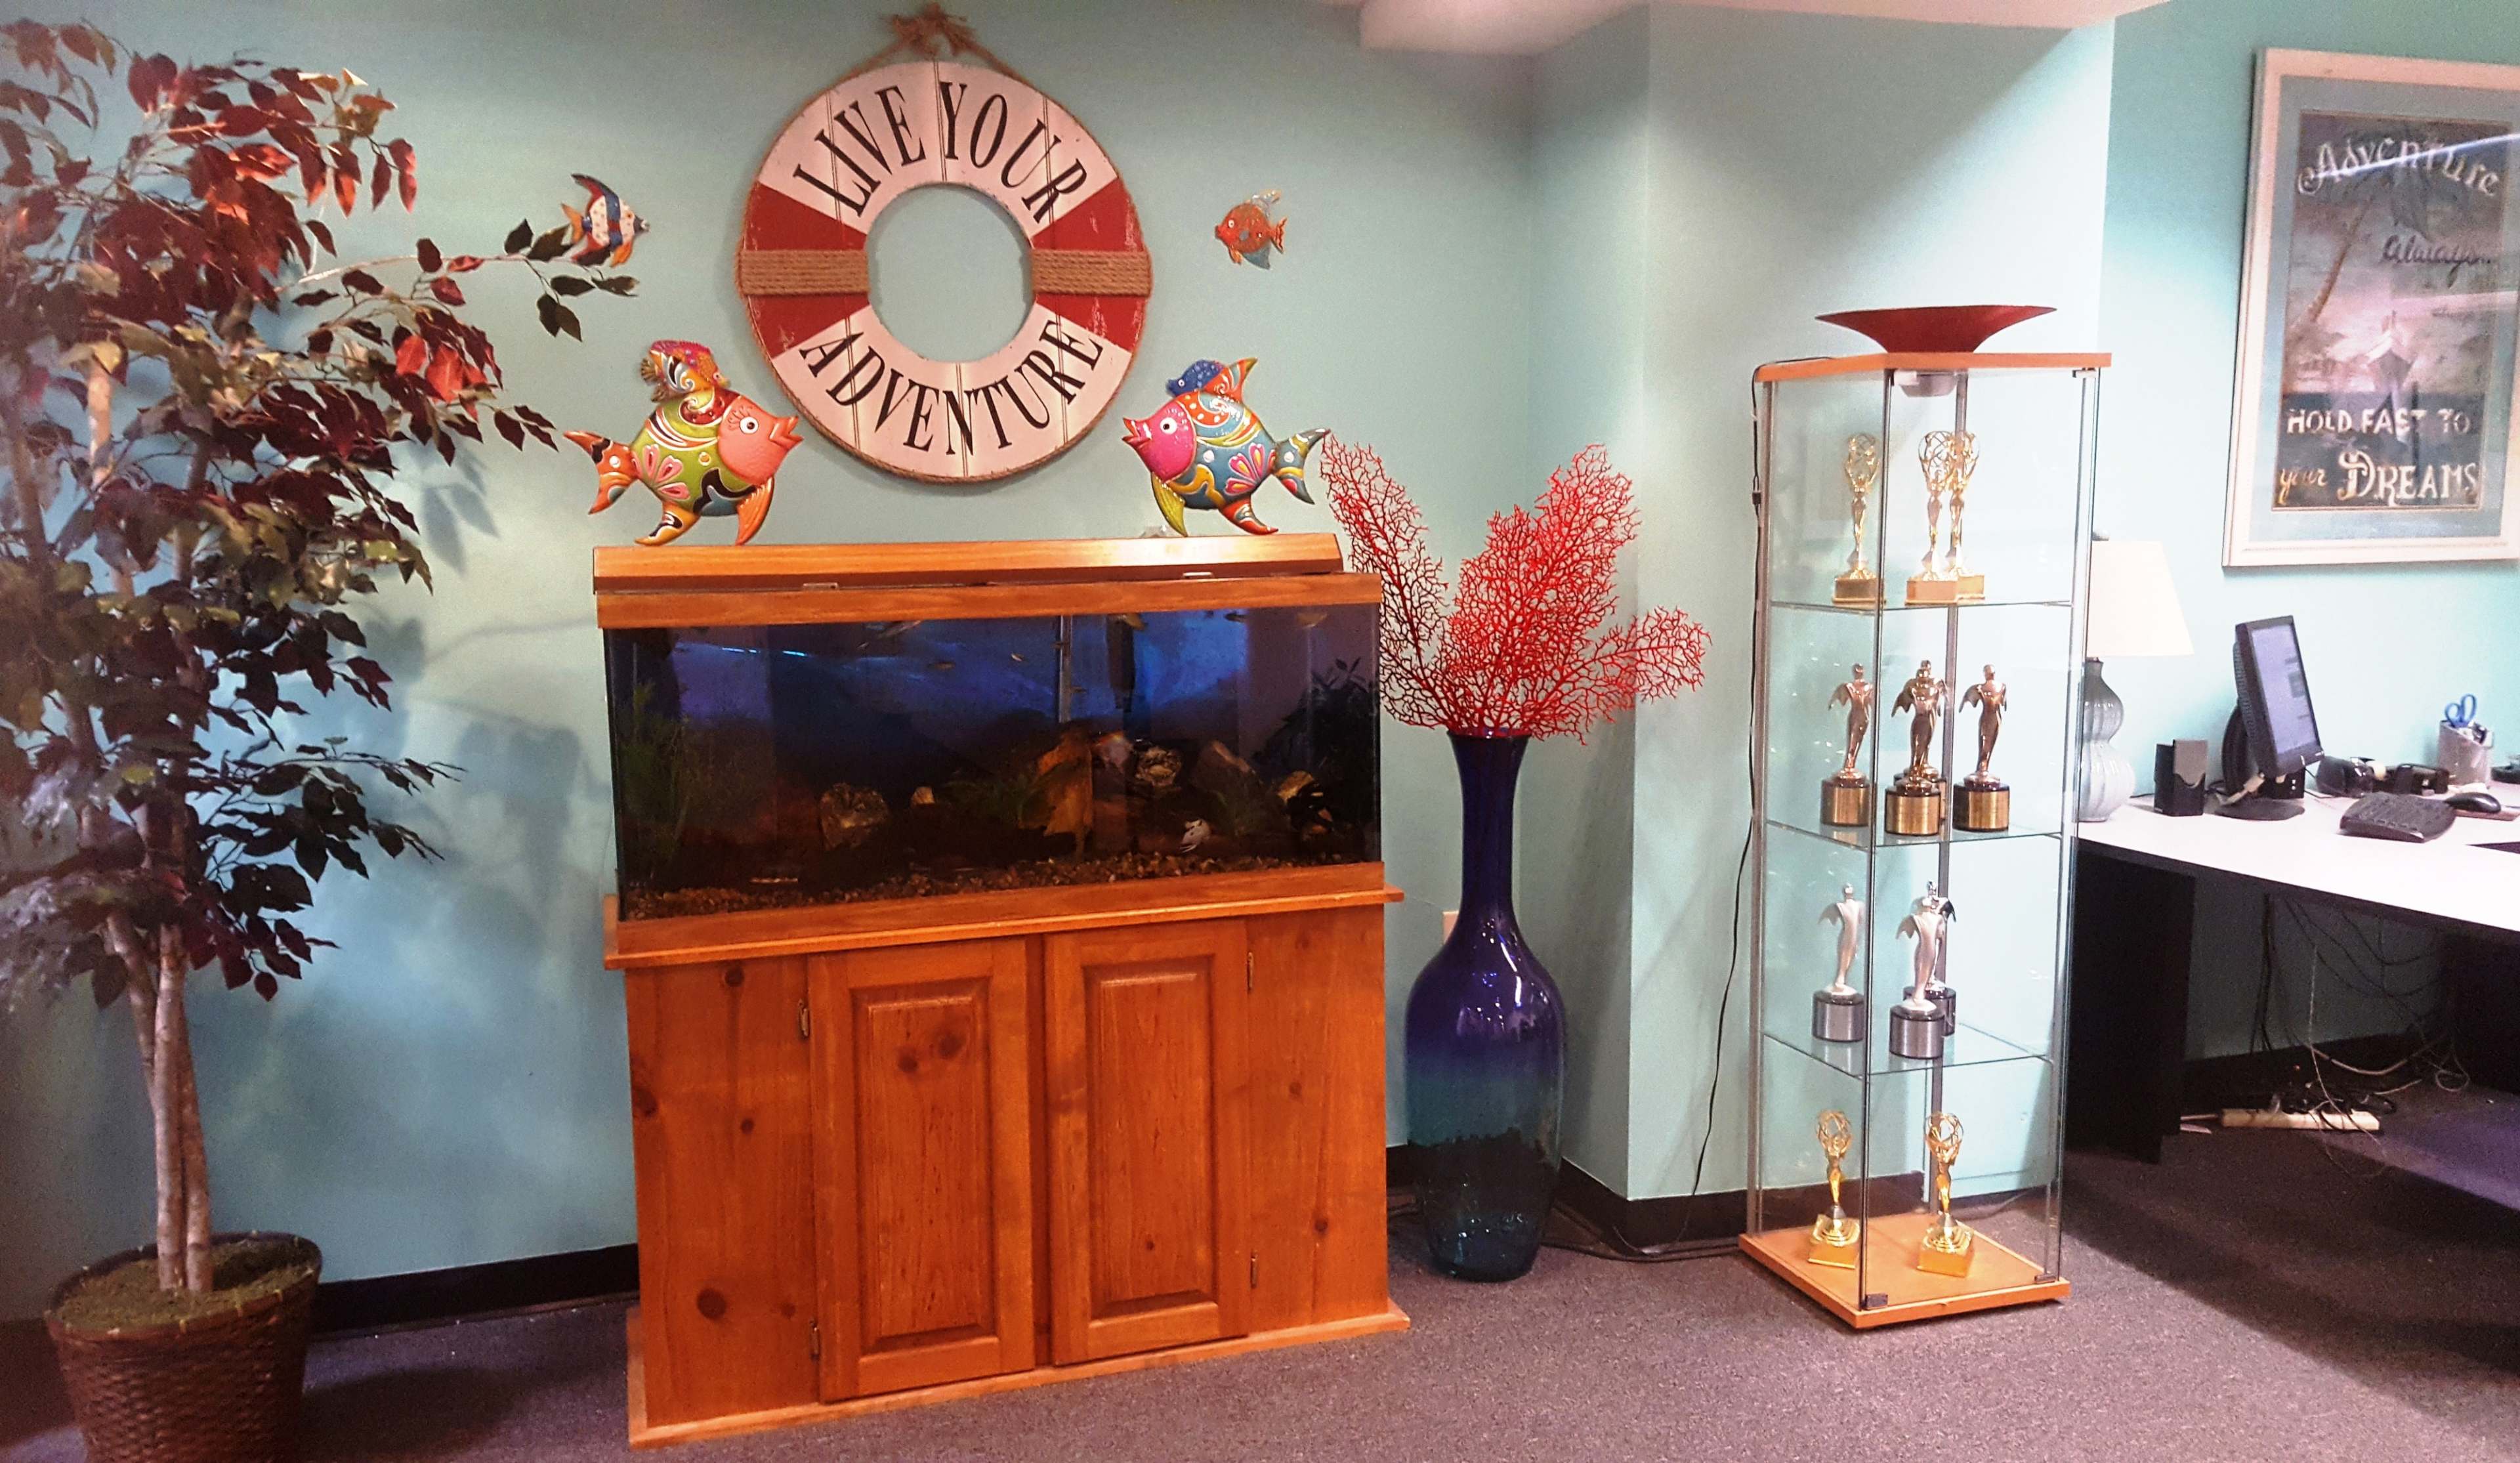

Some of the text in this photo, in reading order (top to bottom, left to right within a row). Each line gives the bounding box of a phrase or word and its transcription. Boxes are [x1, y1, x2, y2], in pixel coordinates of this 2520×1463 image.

[793, 81, 1087, 223] LIVE YOUR
[800, 320, 1104, 456] ADVENTURE
[2287, 408, 2471, 434] HOLD FAST TO
